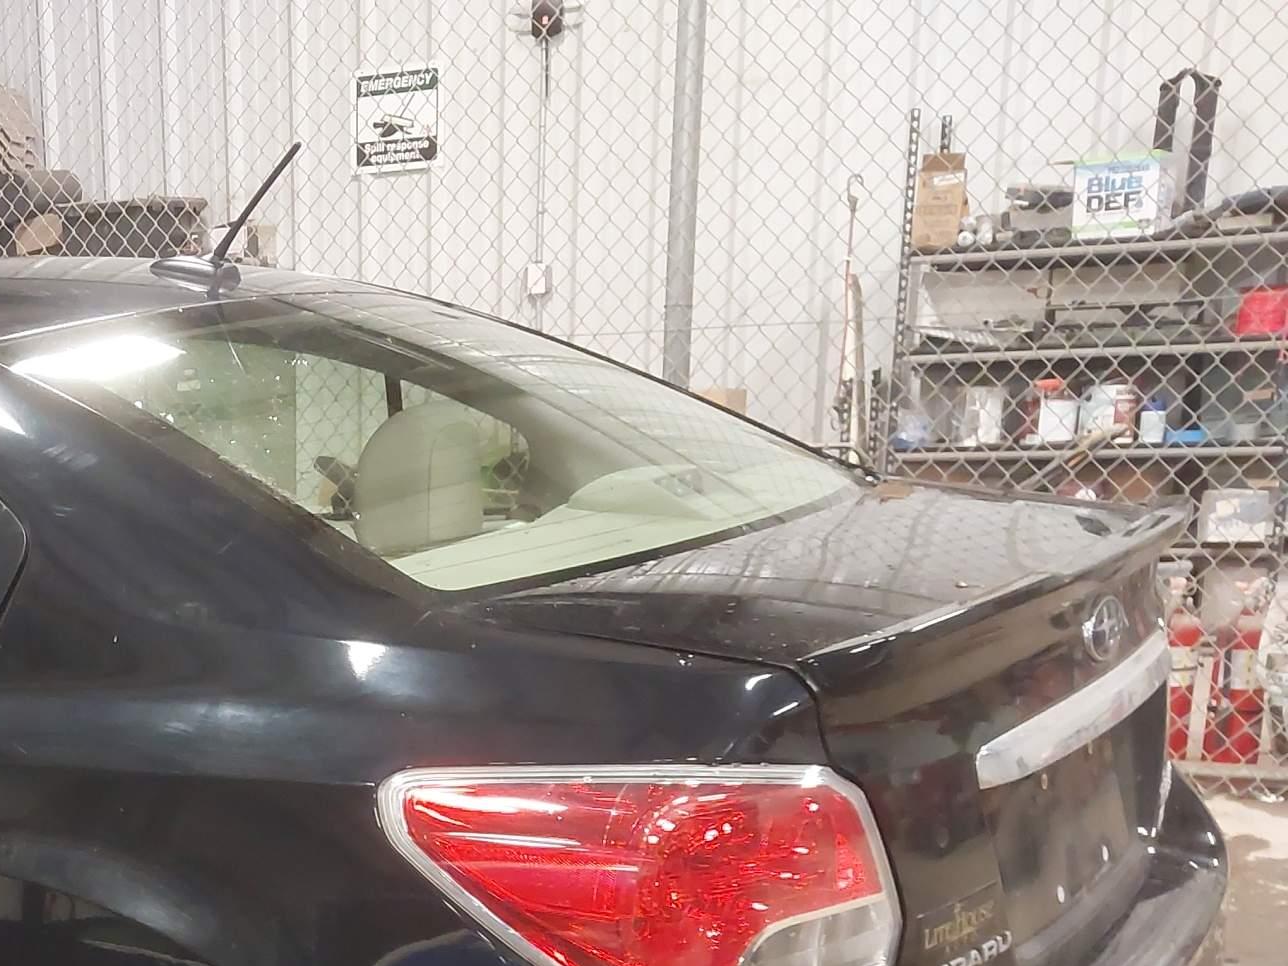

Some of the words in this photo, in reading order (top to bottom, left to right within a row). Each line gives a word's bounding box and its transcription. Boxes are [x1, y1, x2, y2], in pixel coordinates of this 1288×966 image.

[360, 72, 433, 92] EMERGENCY
[364, 141, 385, 154] Spill
[386, 139, 430, 152] response
[369, 148, 420, 164] equipment
[1086, 191, 1141, 213] DEF
